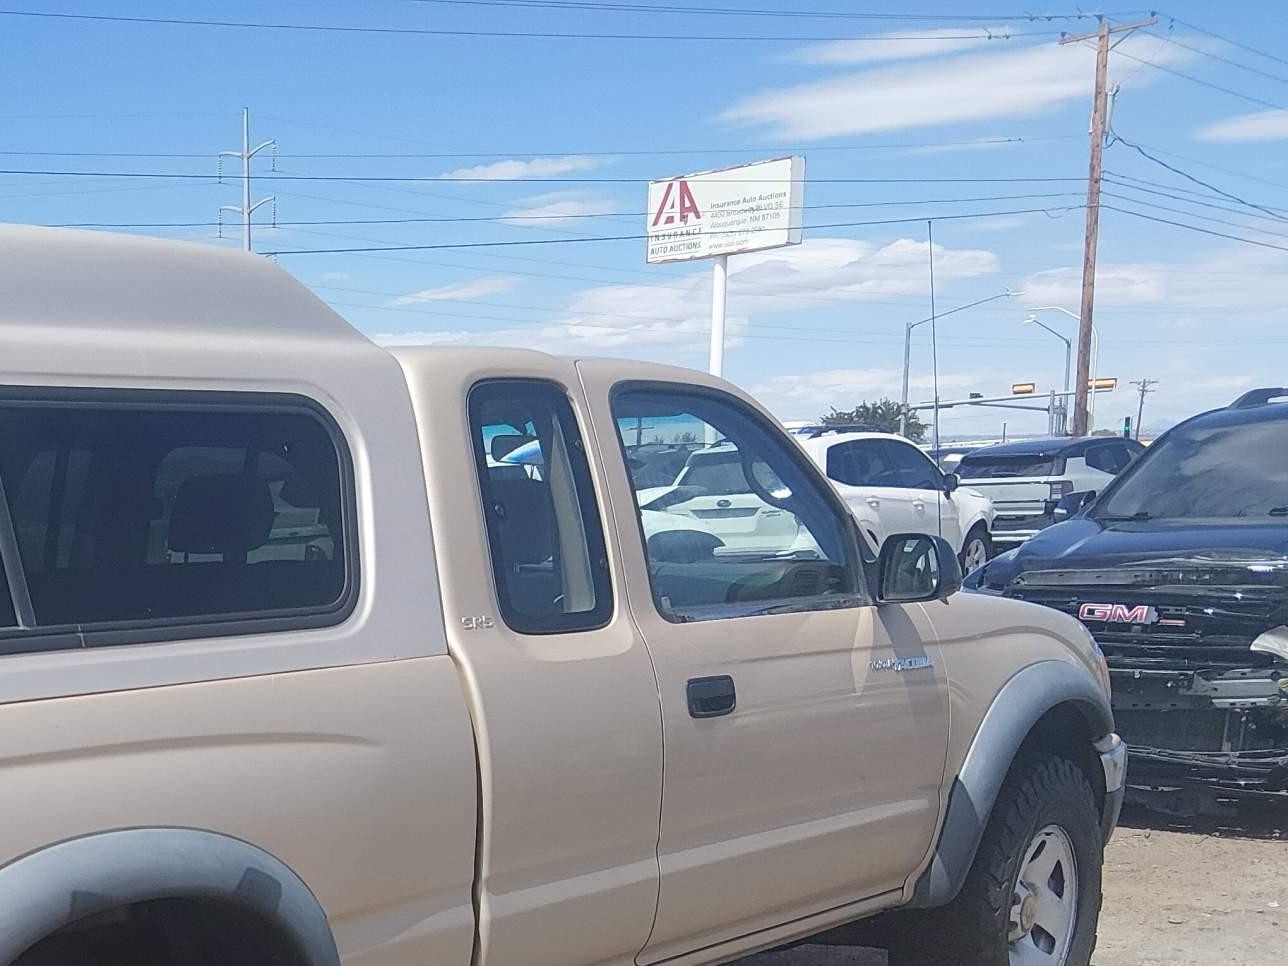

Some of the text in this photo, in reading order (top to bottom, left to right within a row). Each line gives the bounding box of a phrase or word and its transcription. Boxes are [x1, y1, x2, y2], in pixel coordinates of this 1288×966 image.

[710, 191, 787, 209] Insurance Auto Auctions
[775, 200, 784, 209] SE
[750, 215, 760, 224] NM
[650, 227, 702, 243] INSURANCE
[650, 241, 701, 256] AUTO AUCTIONS
